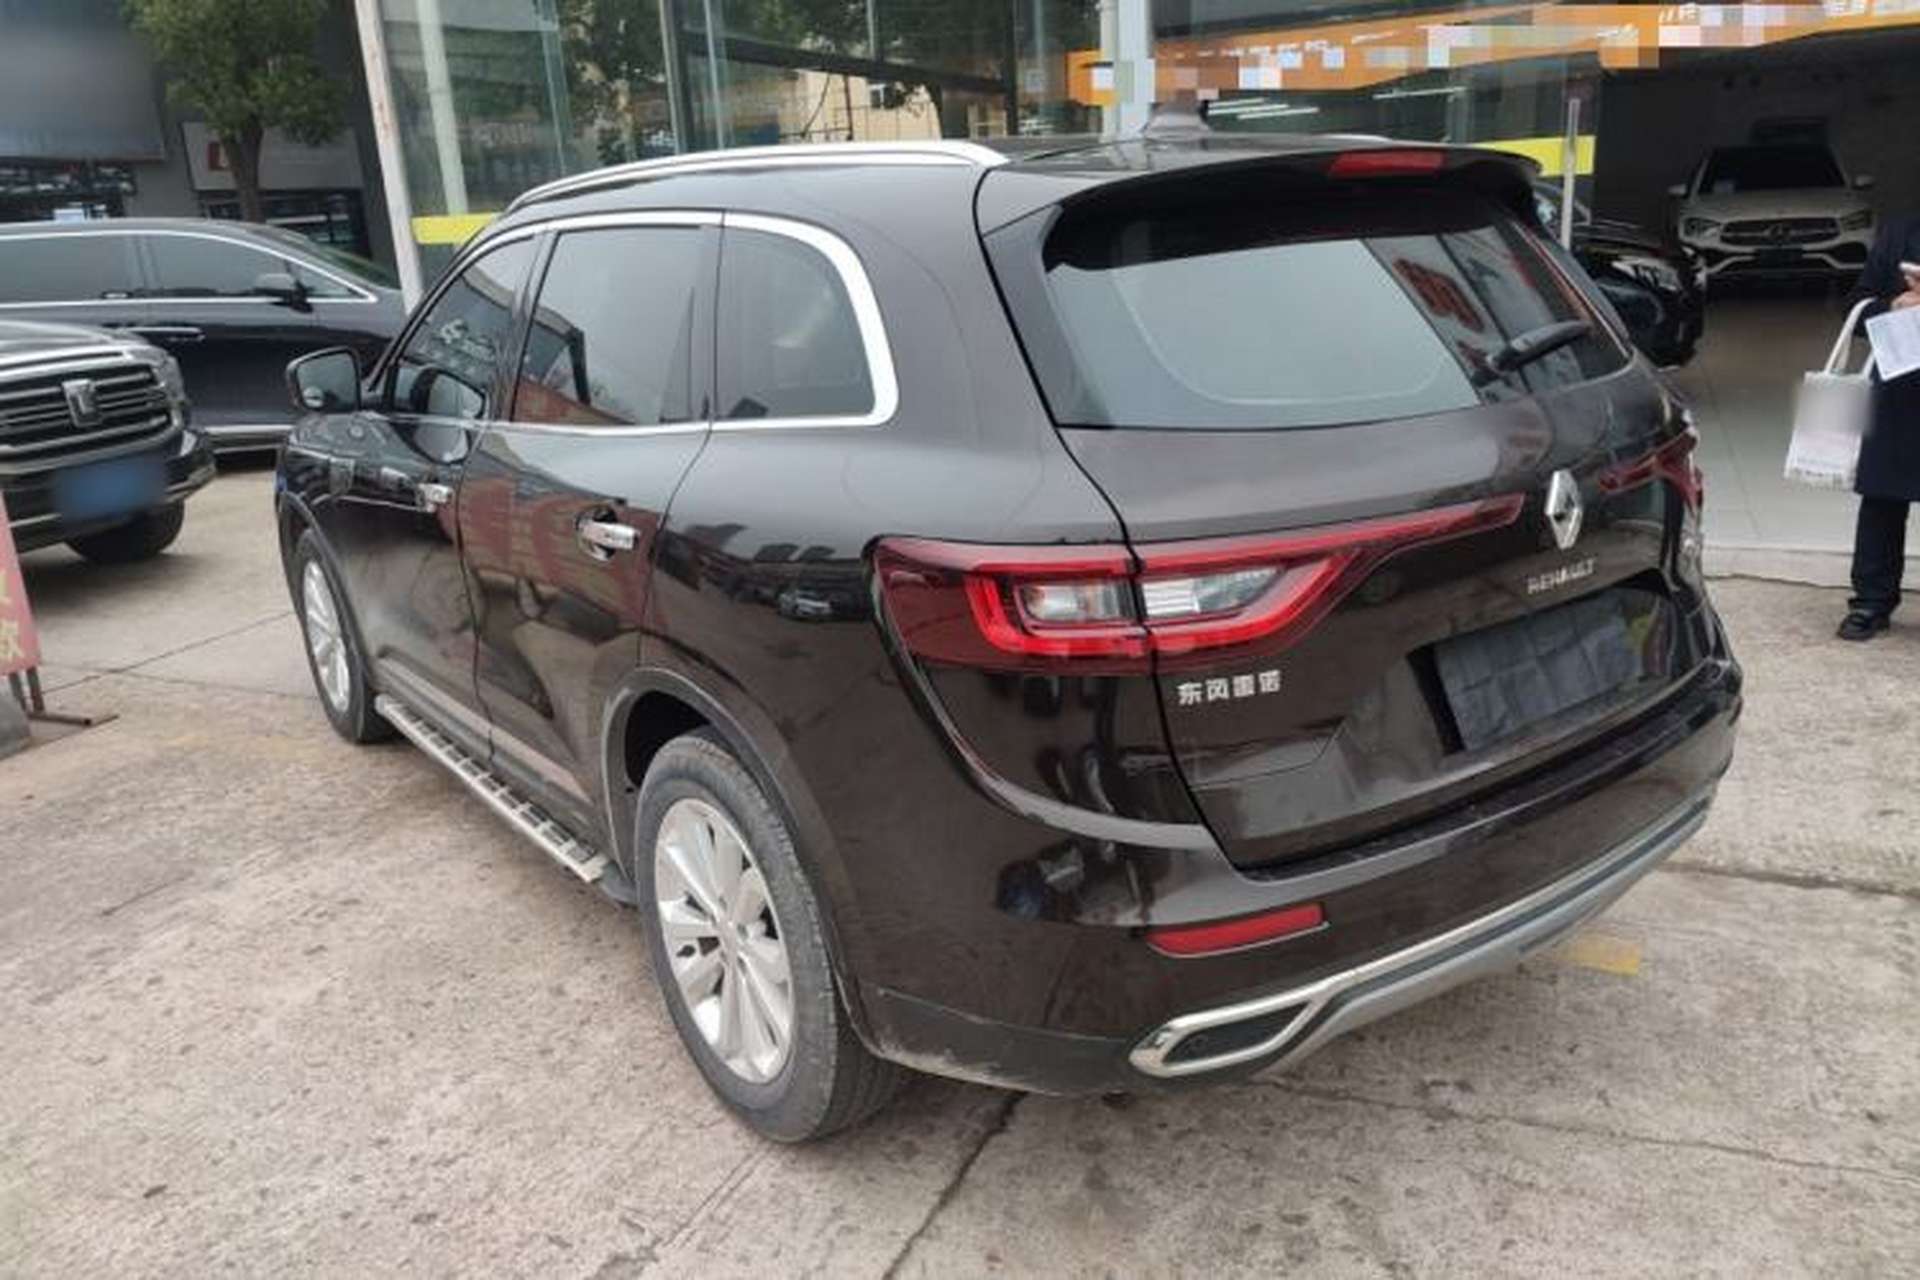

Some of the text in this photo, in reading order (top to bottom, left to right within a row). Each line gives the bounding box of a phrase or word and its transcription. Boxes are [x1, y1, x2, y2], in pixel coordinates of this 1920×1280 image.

[1527, 558, 1595, 594] RENAULT
[1177, 670, 1280, 705] 东风雷诺
